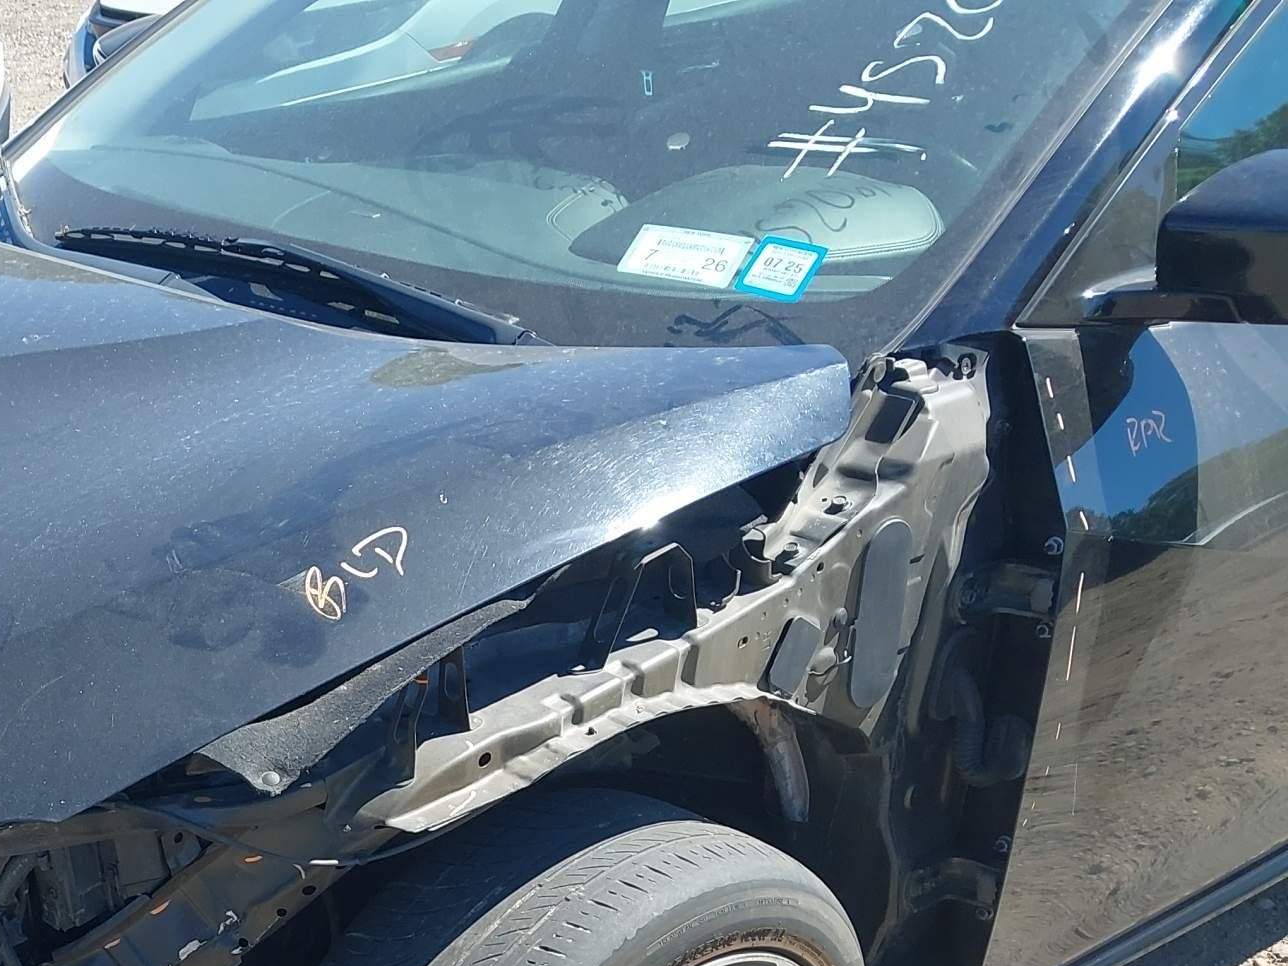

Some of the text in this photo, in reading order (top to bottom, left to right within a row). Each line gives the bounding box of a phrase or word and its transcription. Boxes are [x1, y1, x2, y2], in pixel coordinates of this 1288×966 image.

[701, 258, 729, 273] 26
[763, 256, 804, 274] 07 25
